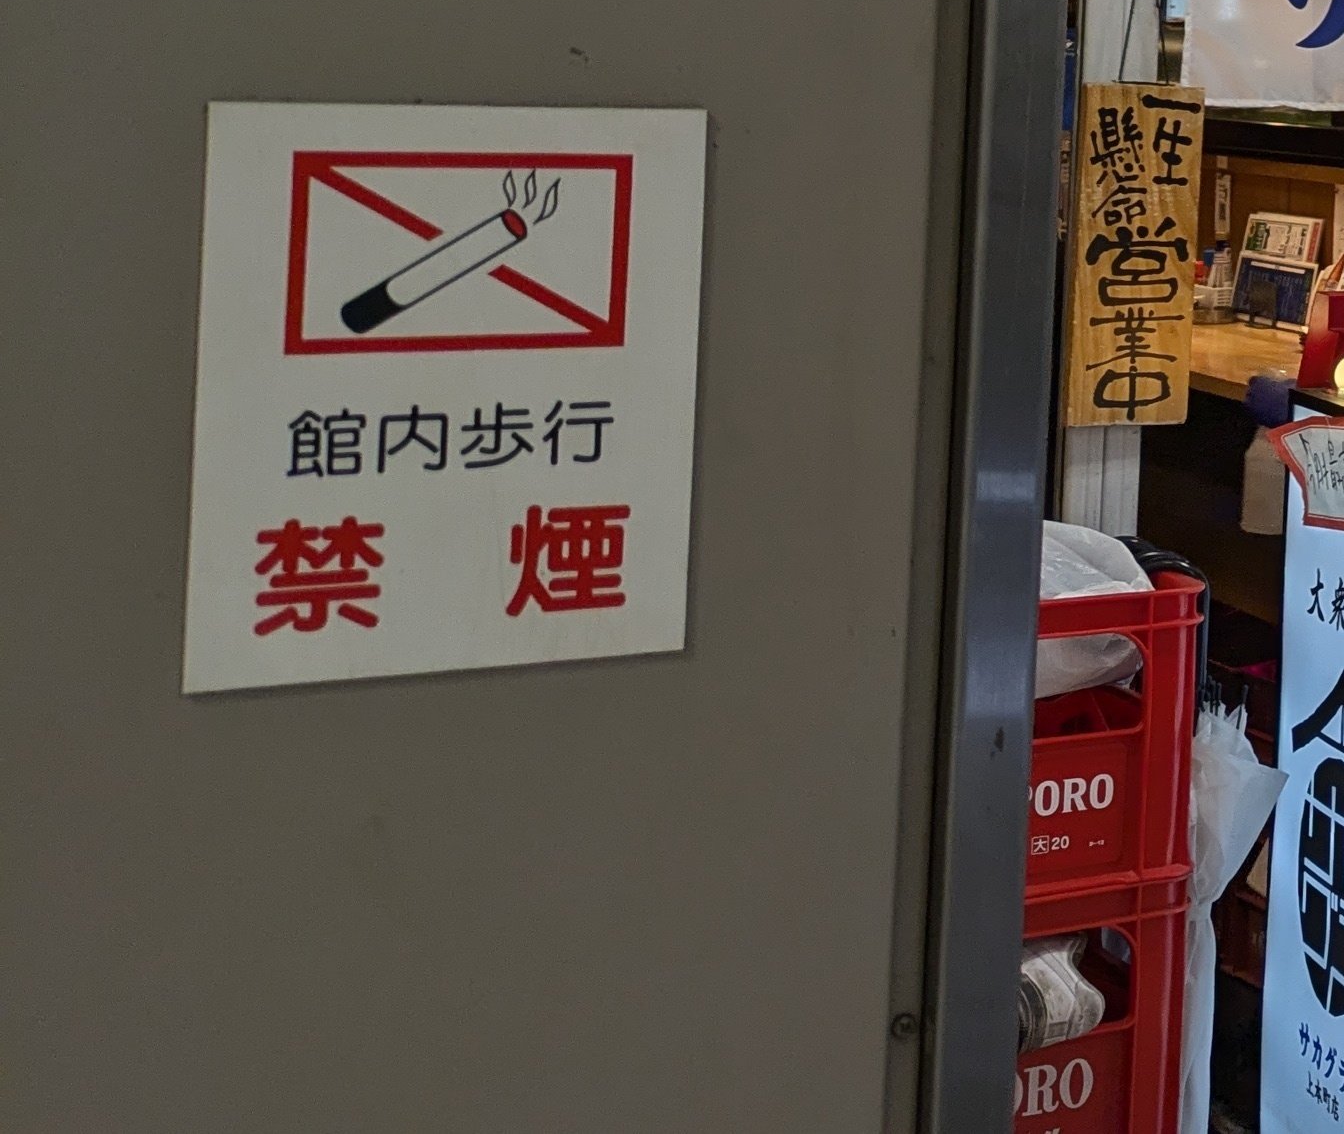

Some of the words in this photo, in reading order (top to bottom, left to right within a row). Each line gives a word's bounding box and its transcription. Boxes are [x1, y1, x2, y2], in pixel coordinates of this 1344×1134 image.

[1090, 106, 1148, 227] 懸命
[1142, 93, 1202, 187] 一生
[1085, 216, 1189, 422] 営業中
[286, 401, 615, 479] 館内歩行
[1029, 772, 1115, 818] ORO
[1050, 834, 1070, 851] 20
[1014, 1057, 1095, 1118] RO
[1305, 1070, 1340, 1122] 上本町店
